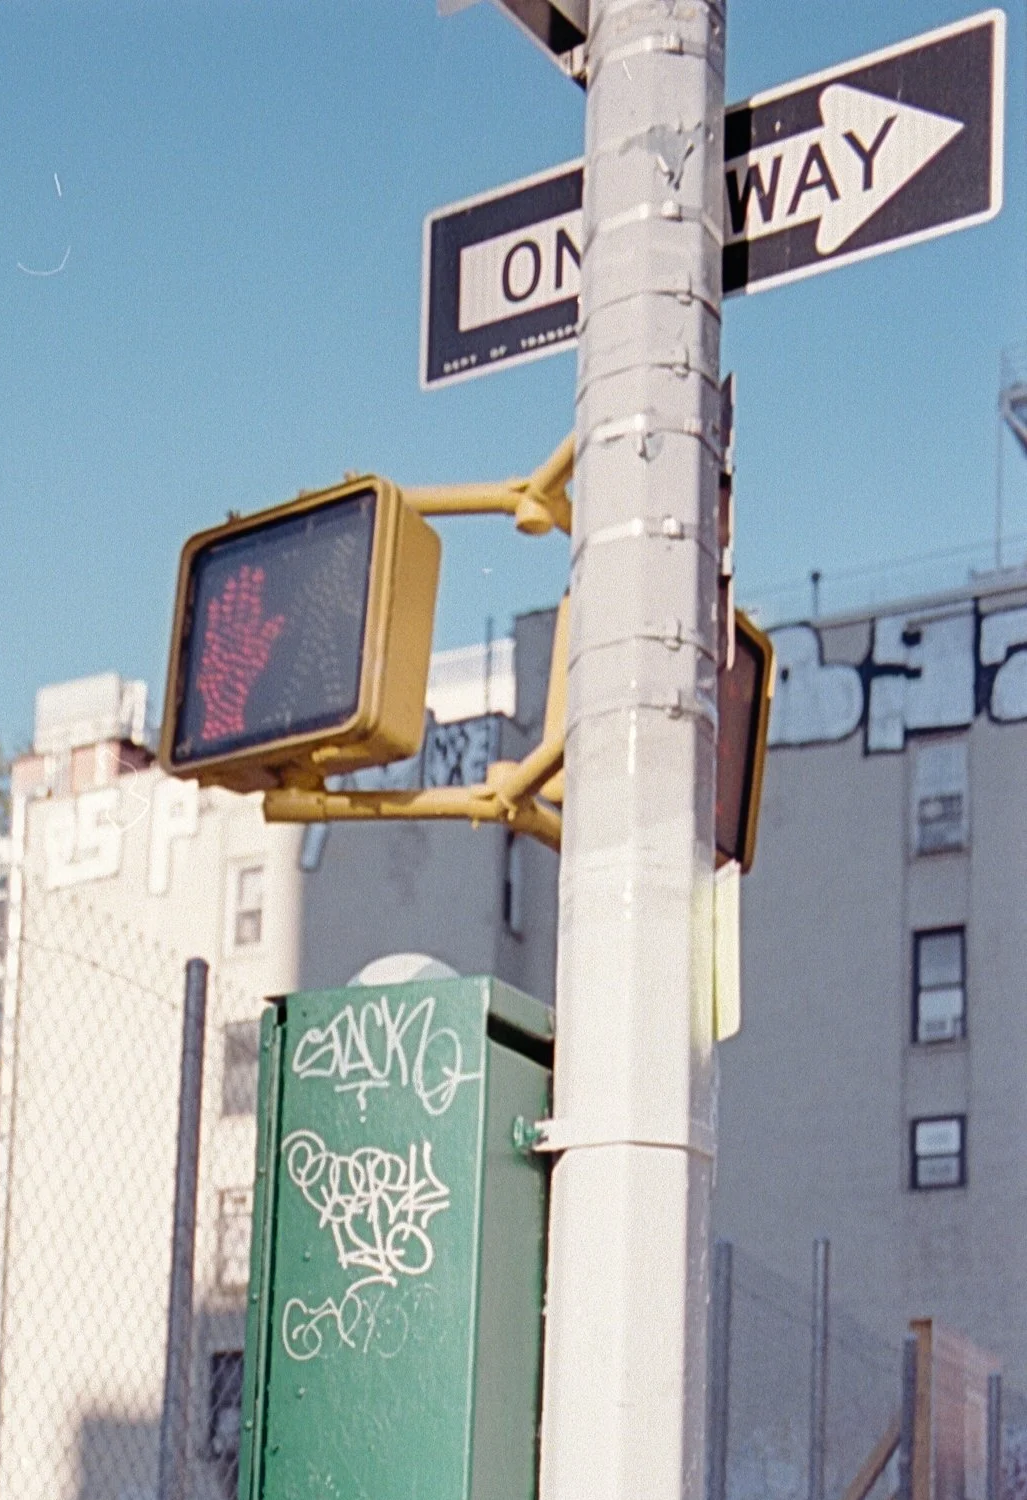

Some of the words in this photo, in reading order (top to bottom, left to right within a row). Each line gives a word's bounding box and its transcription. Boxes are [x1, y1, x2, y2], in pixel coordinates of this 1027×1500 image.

[501, 228, 583, 304] ON
[725, 115, 898, 236] WAY
[521, 323, 579, 350] TRANSP
